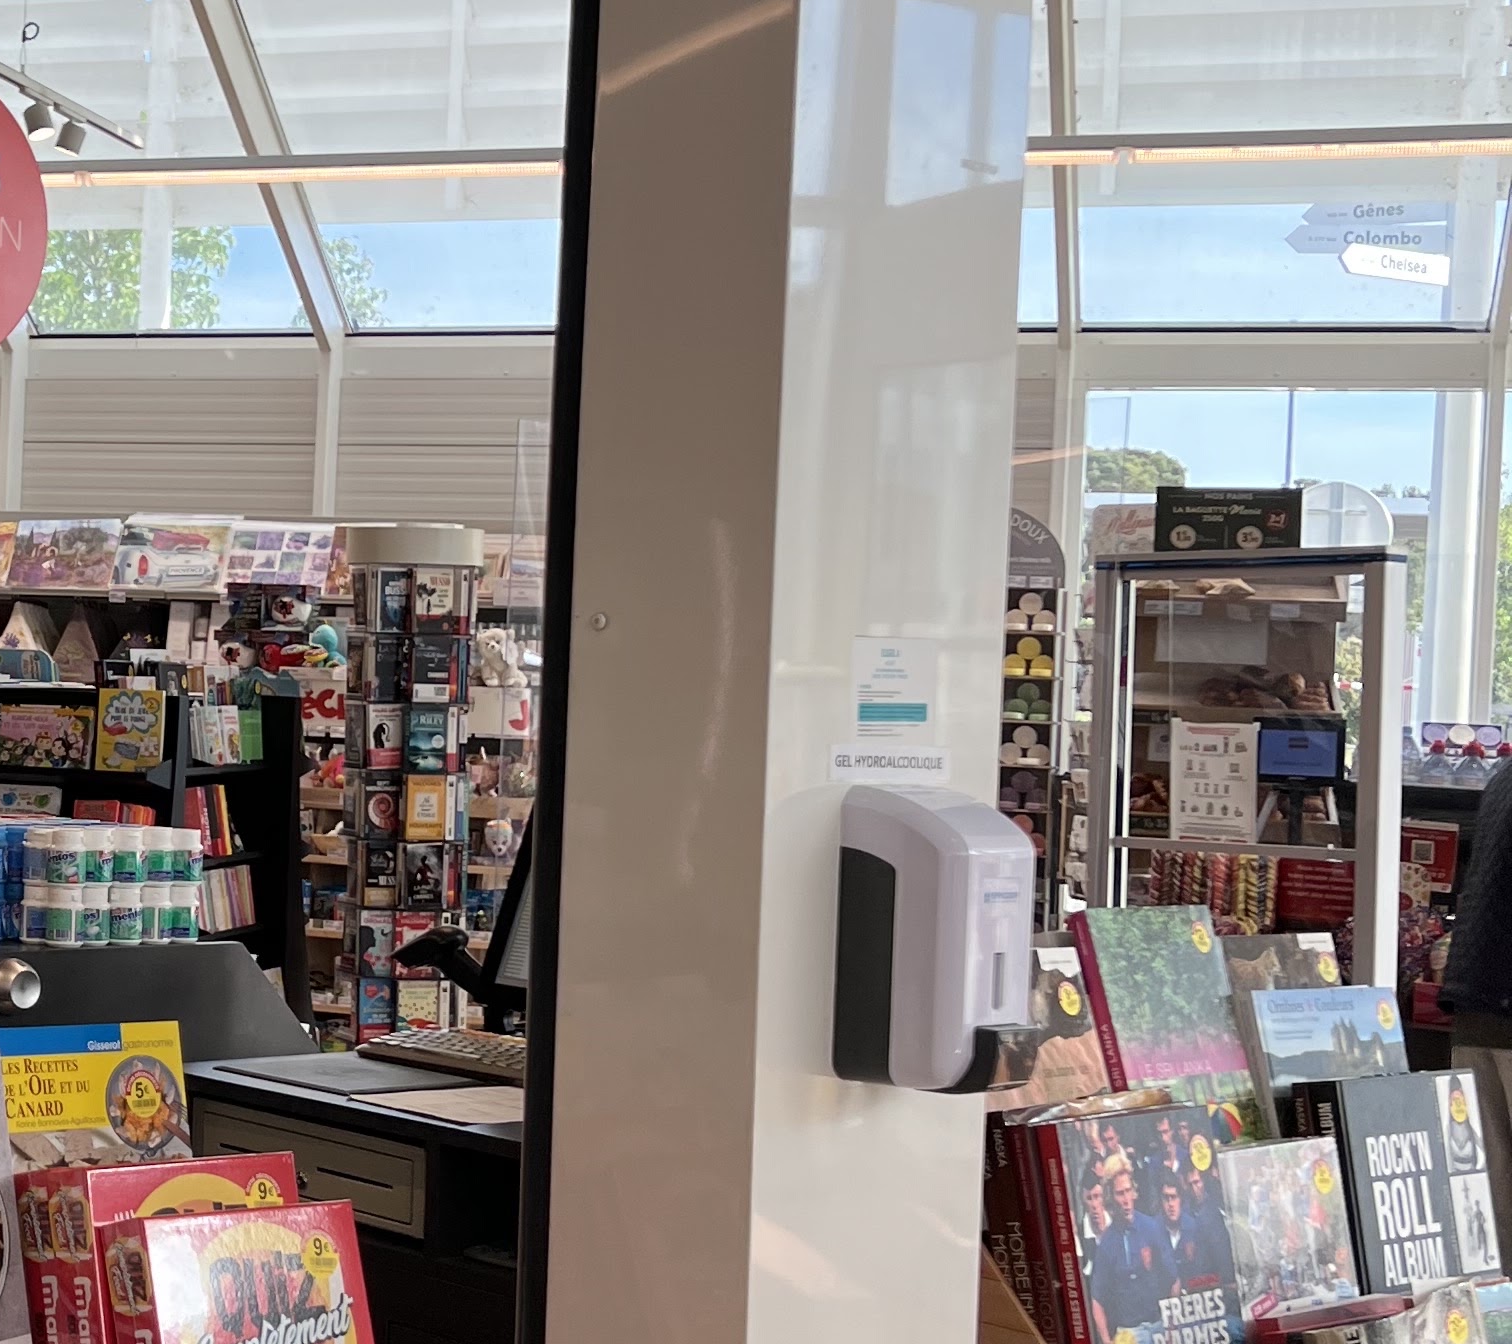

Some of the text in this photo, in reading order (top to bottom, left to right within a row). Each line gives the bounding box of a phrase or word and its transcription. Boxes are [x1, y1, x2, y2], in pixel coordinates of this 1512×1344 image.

[1352, 202, 1405, 219] Gênes
[1343, 230, 1423, 246] Colombo
[1380, 254, 1428, 275] Chelsea
[834, 753, 852, 769] GEL
[1364, 1130, 1434, 1178] ROCK'N
[1372, 1175, 1443, 1241] ROLL
[1383, 1236, 1449, 1288] ALBUM
[1158, 1286, 1226, 1328] FRÈRES
